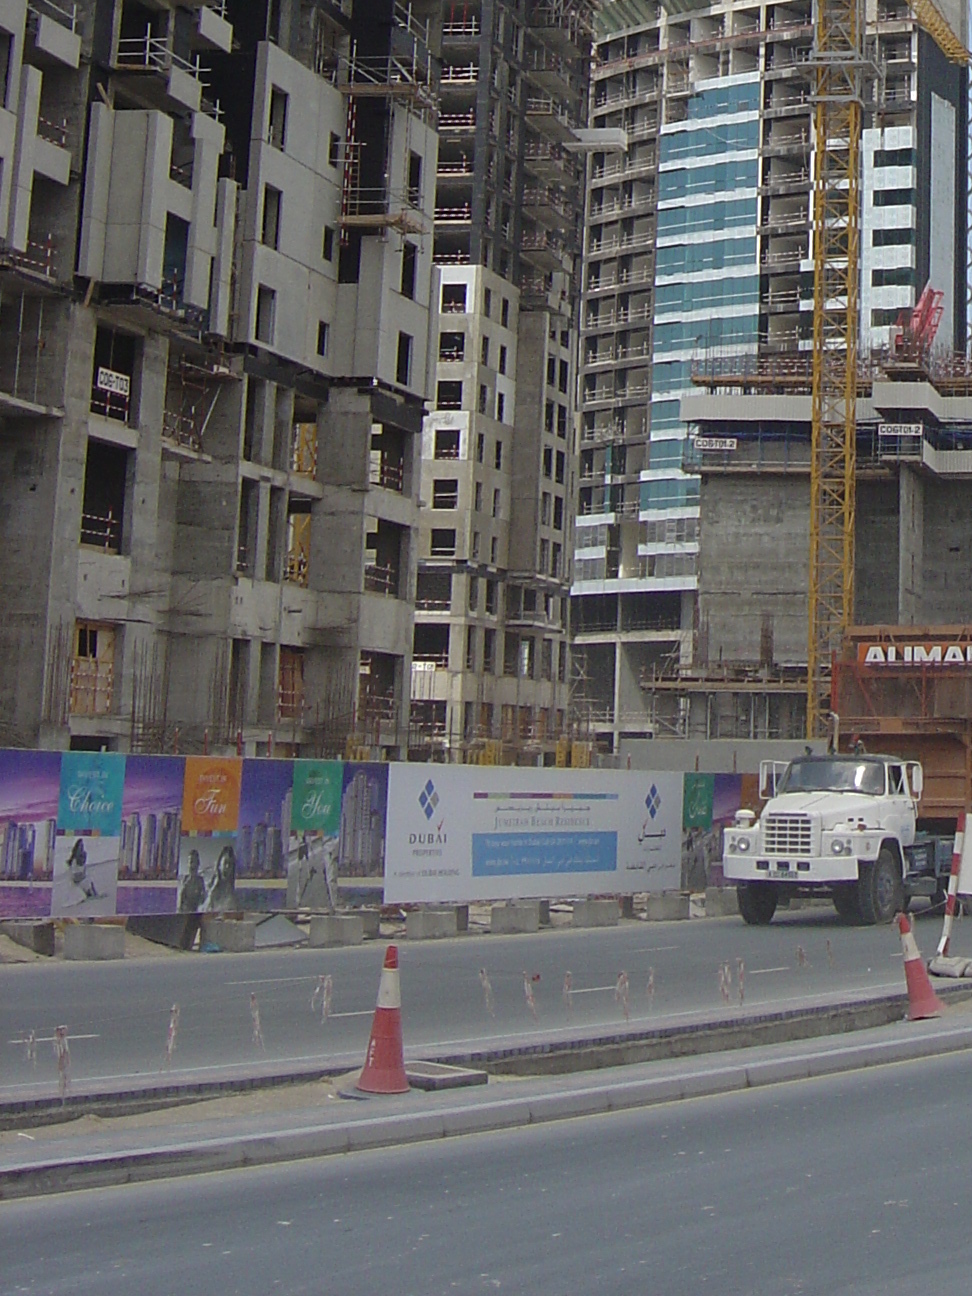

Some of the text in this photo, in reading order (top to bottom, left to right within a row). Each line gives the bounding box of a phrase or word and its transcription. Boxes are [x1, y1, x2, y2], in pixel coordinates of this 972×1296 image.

[67, 784, 115, 813] Choice
[193, 788, 227, 815] Fun
[301, 789, 332, 819] You
[409, 833, 447, 845] DUBAI
